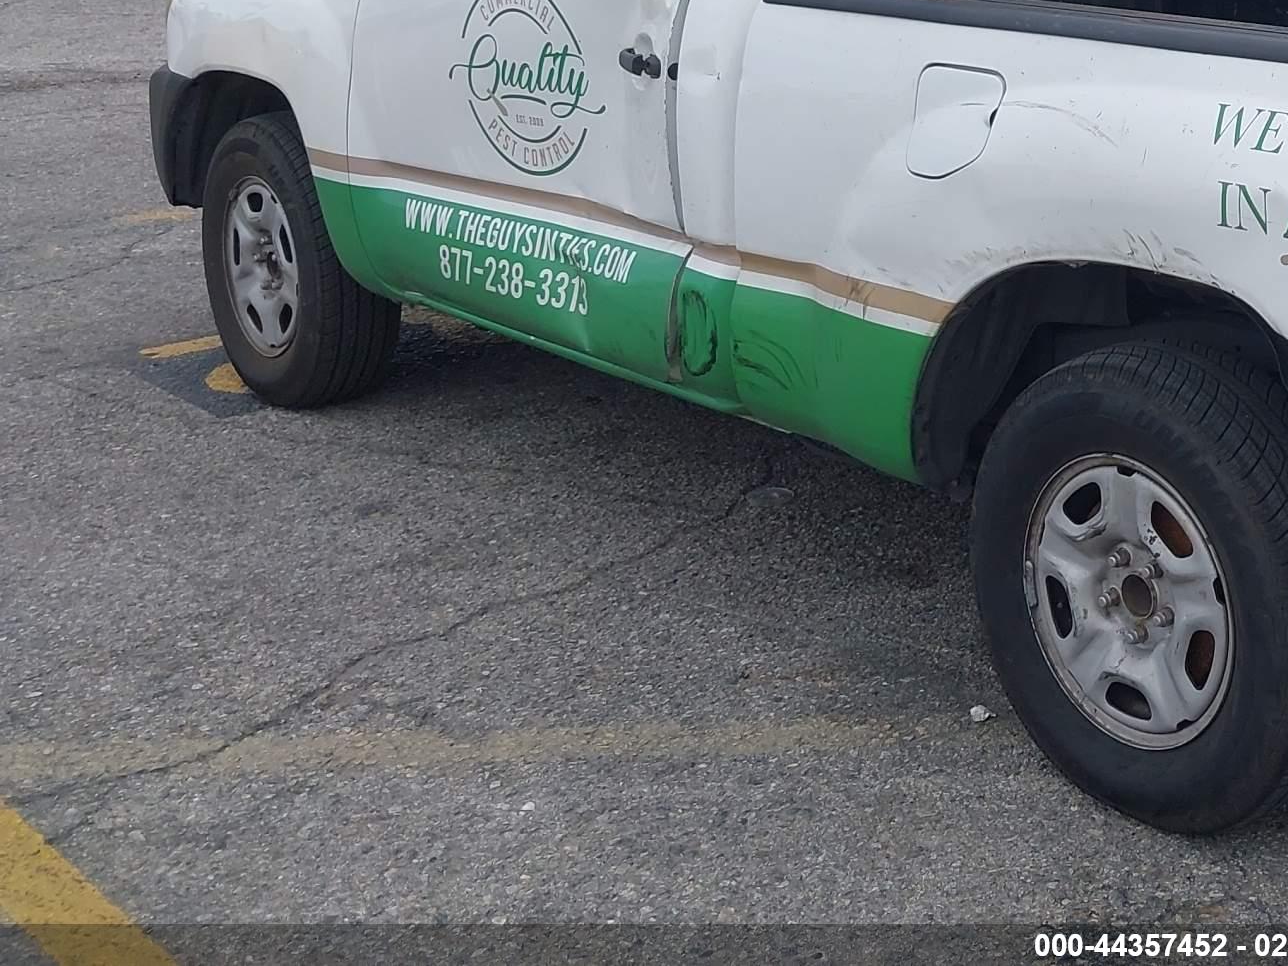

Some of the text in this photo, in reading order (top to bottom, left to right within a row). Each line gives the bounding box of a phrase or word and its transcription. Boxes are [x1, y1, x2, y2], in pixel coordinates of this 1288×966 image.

[449, 34, 606, 118] Quality
[488, 118, 576, 167] PEST CONTROL
[405, 198, 637, 284] WWW.THEGUYSINTIES.COM
[1216, 180, 1271, 234] IN
[439, 244, 589, 316] 877-238-3313
